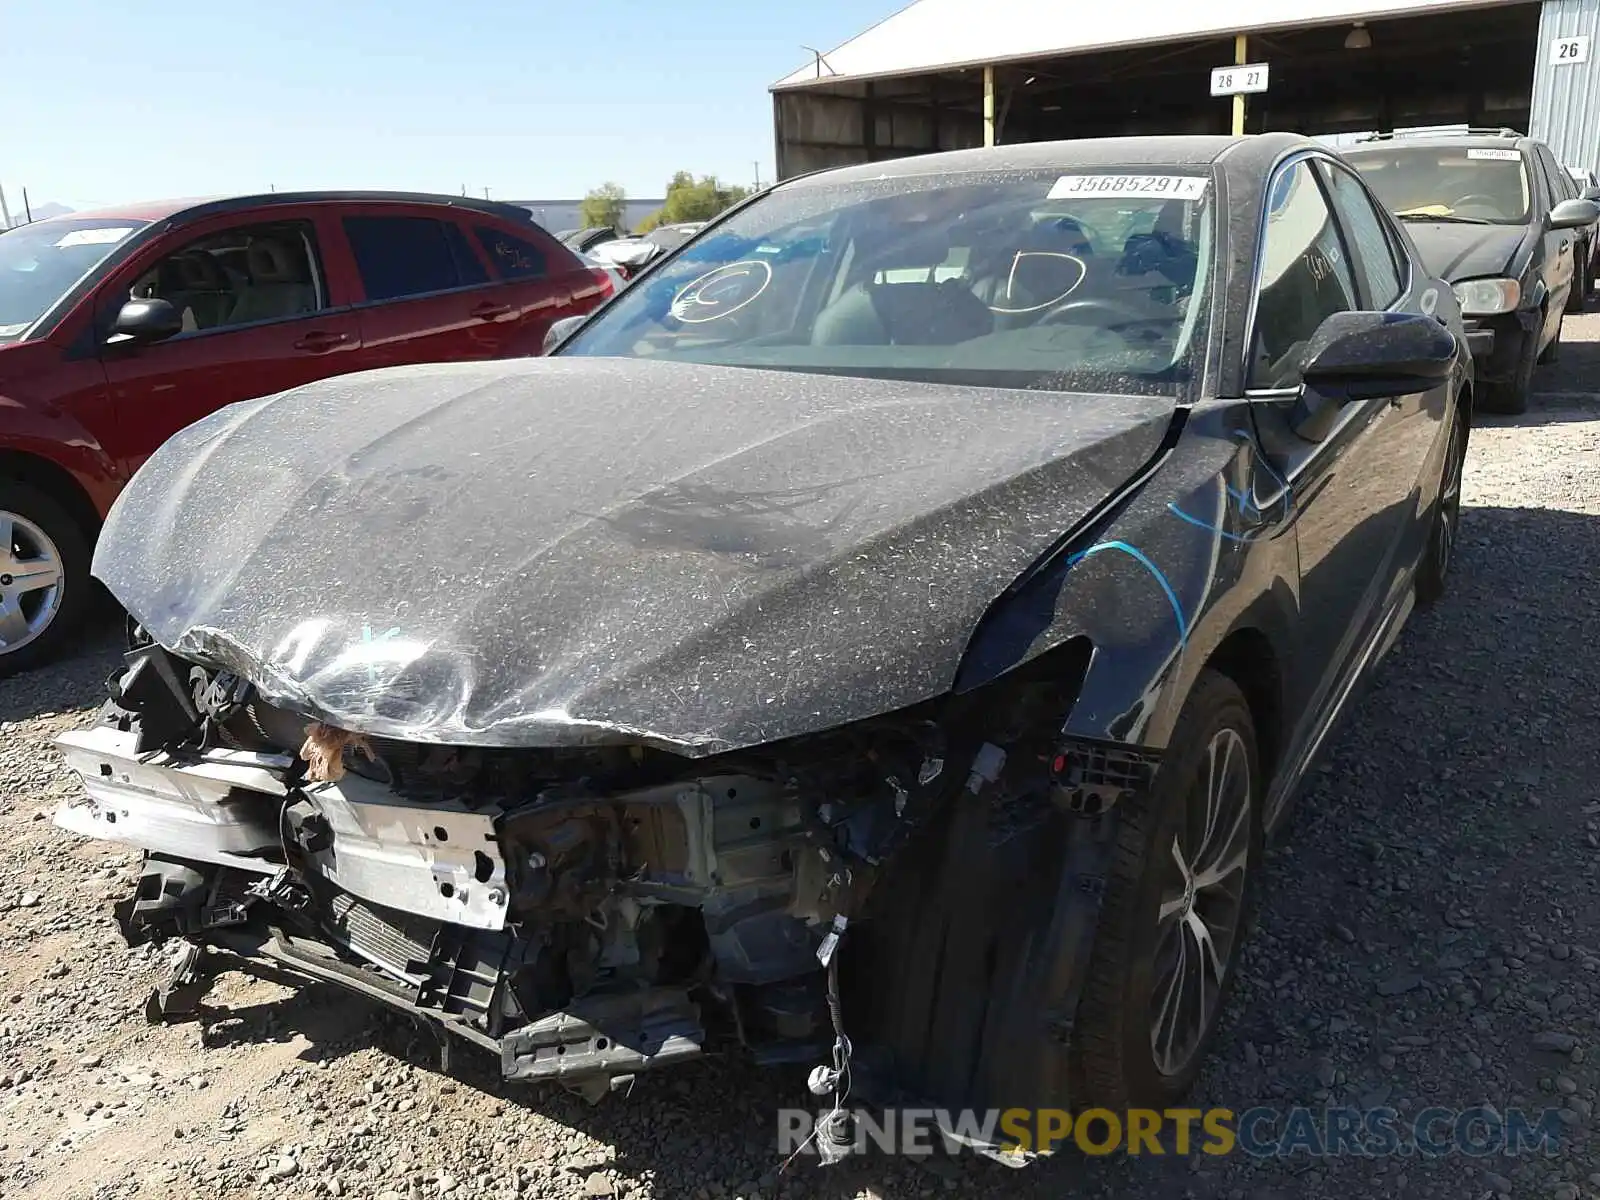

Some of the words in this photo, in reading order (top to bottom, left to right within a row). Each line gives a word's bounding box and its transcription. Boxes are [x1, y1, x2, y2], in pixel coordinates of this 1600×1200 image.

[1559, 42, 1578, 58] 26
[1218, 74, 1233, 88] 28
[1247, 71, 1260, 86] 27
[1069, 177, 1183, 193] 35685291
